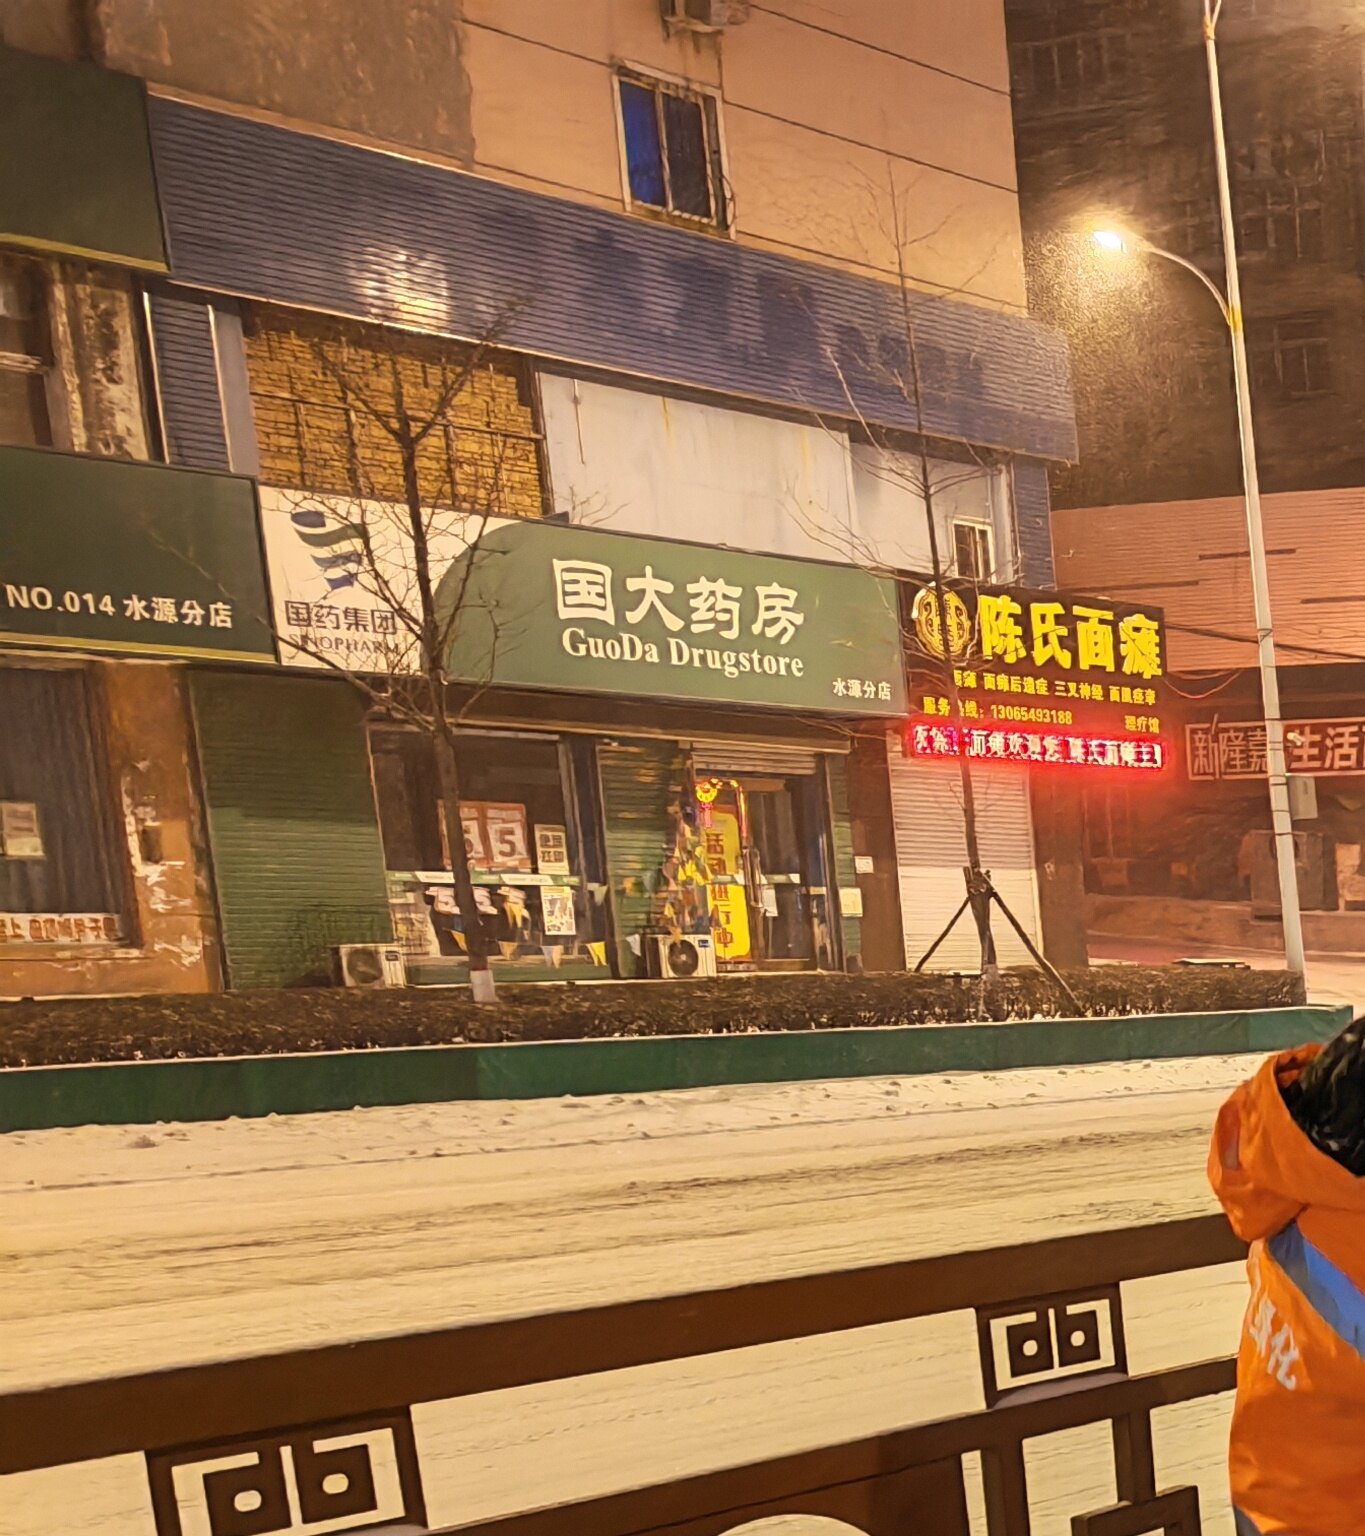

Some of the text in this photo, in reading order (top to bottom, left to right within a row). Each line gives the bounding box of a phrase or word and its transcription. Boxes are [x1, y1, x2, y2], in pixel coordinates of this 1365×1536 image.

[6, 584, 232, 628] NO.014 水源分店
[285, 600, 396, 634] 国药集团
[552, 558, 804, 645] 国大药房
[562, 627, 804, 678] GuoDa Drugstore
[979, 594, 1162, 679] 陈氏面瘫
[832, 678, 892, 701] 水源分店
[991, 704, 1073, 726] 13065493188
